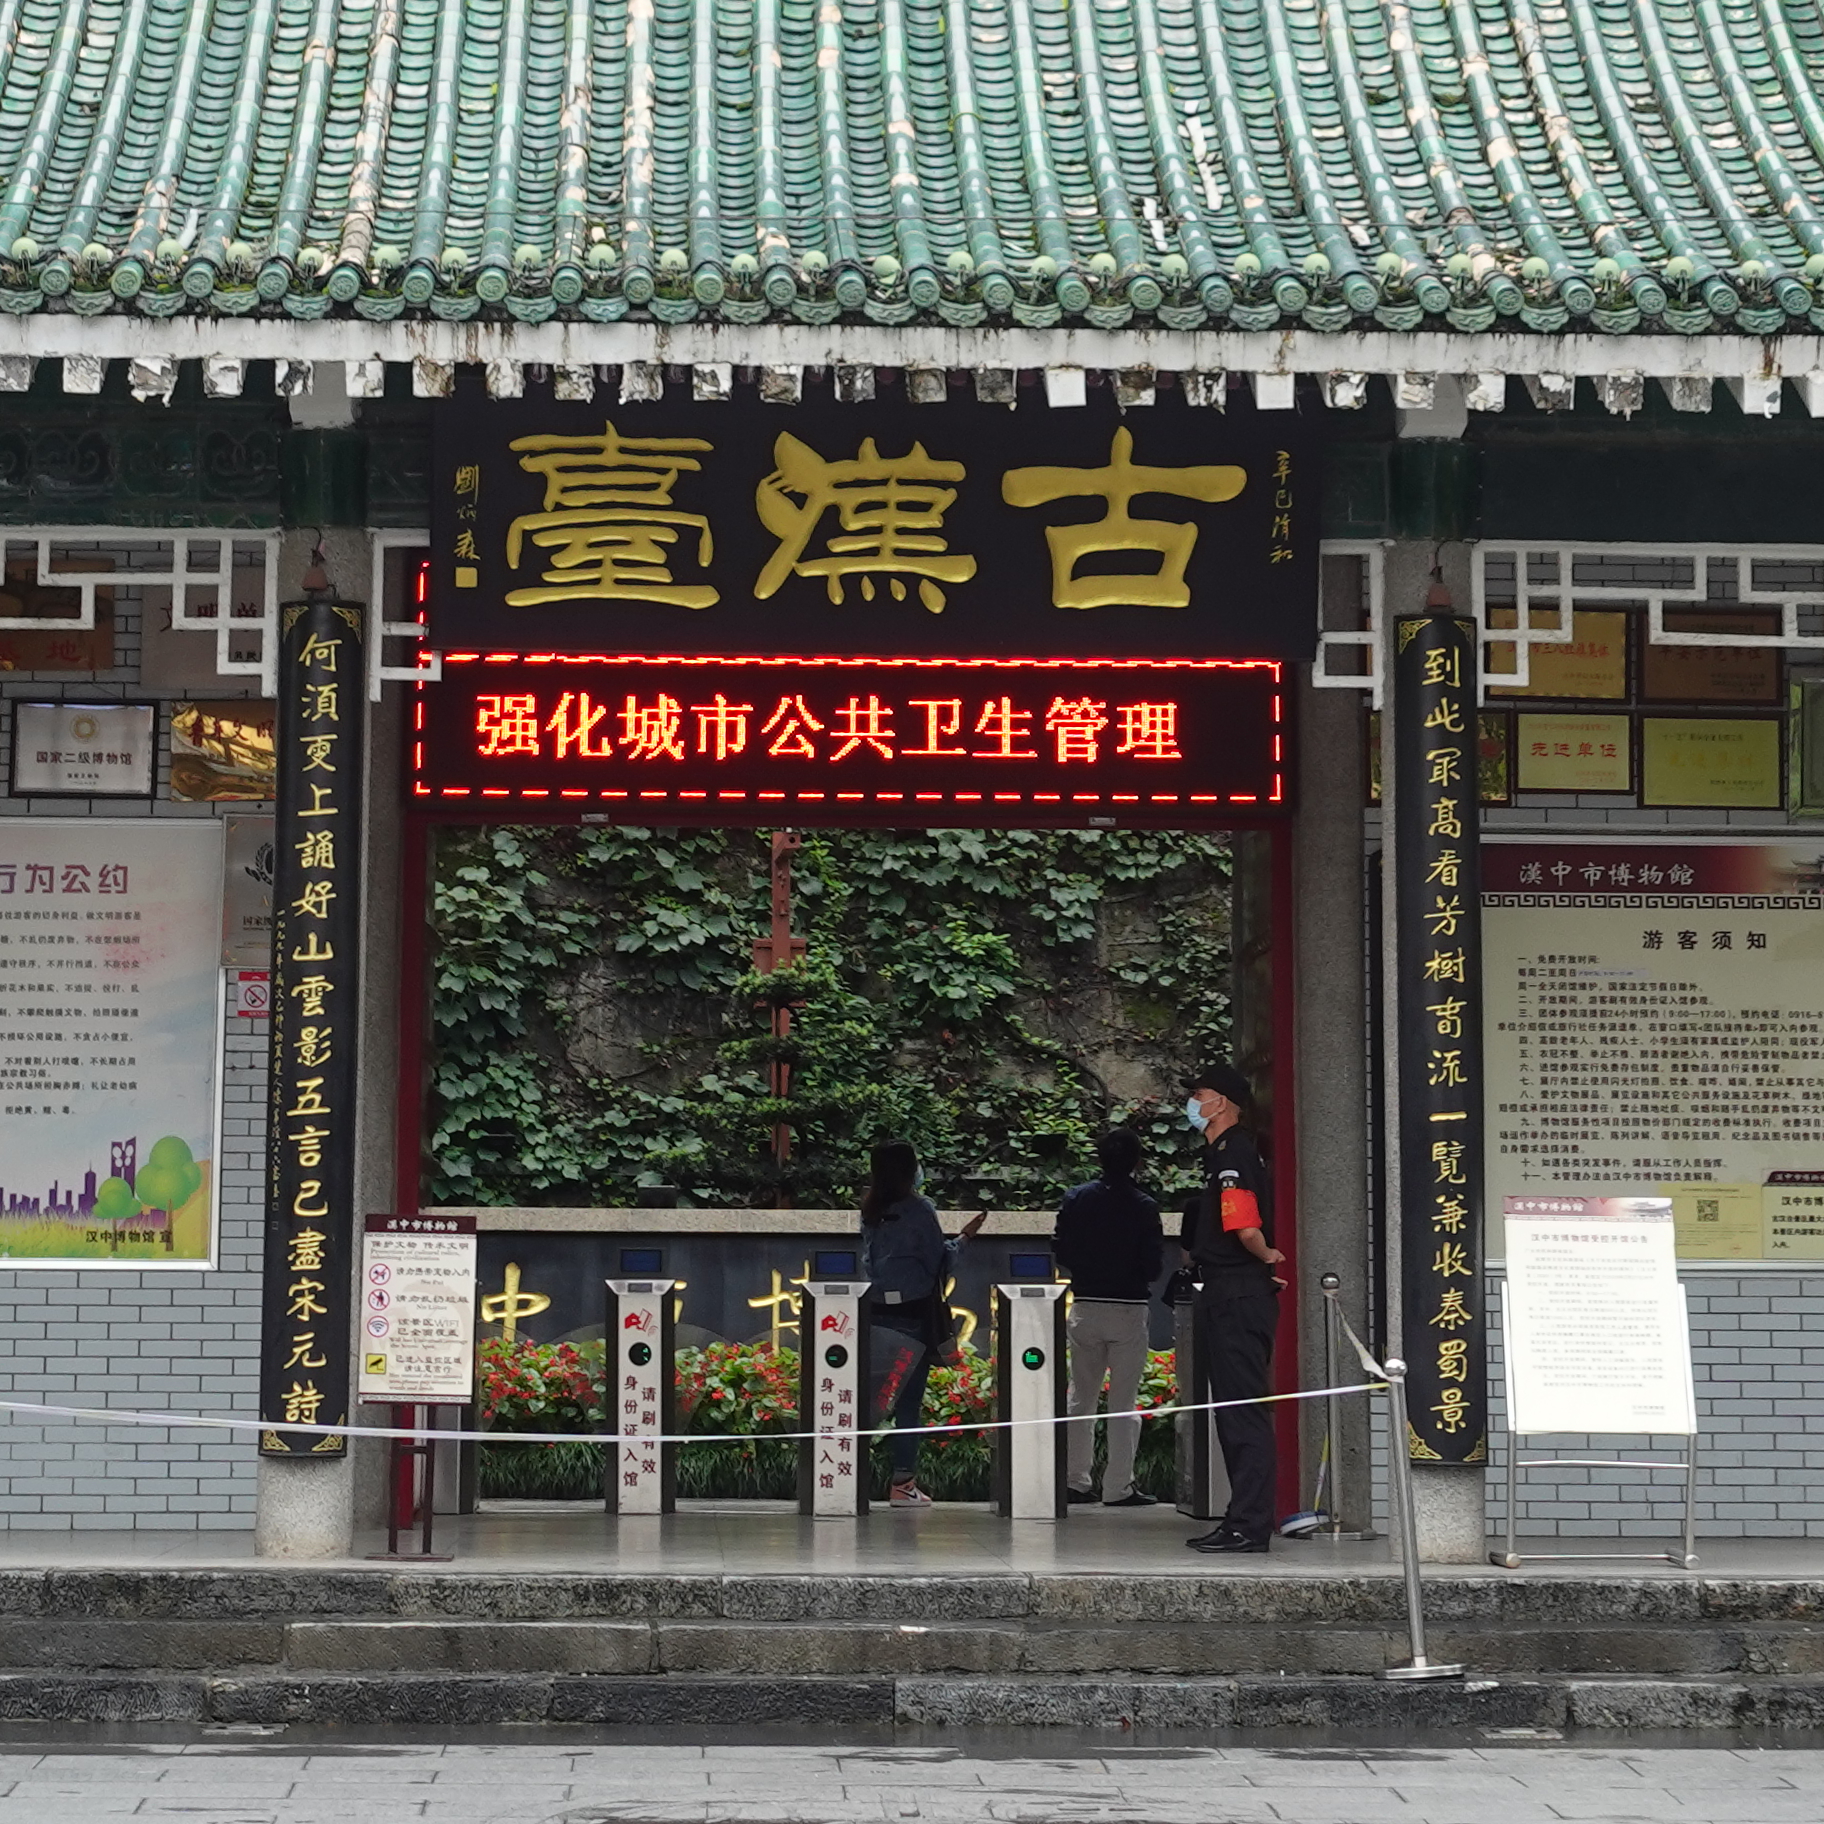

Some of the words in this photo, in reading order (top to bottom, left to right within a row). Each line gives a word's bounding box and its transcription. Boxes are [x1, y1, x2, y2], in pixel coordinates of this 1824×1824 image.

[35, 750, 133, 766] 国家二级博物馆
[475, 692, 1184, 764] 强化城市公共卫生管理
[1519, 861, 1696, 888] 漢中市博物館
[1641, 929, 1768, 952] 游客须知
[370, 1240, 418, 1249] 保护文物
[422, 1241, 470, 1250] 传承文明
[622, 1375, 639, 1488] 身份证入馆
[640, 1386, 658, 1475] 请刷有效
[818, 1377, 836, 1490] 身份证入馆
[836, 1387, 854, 1478] 请刷有效
